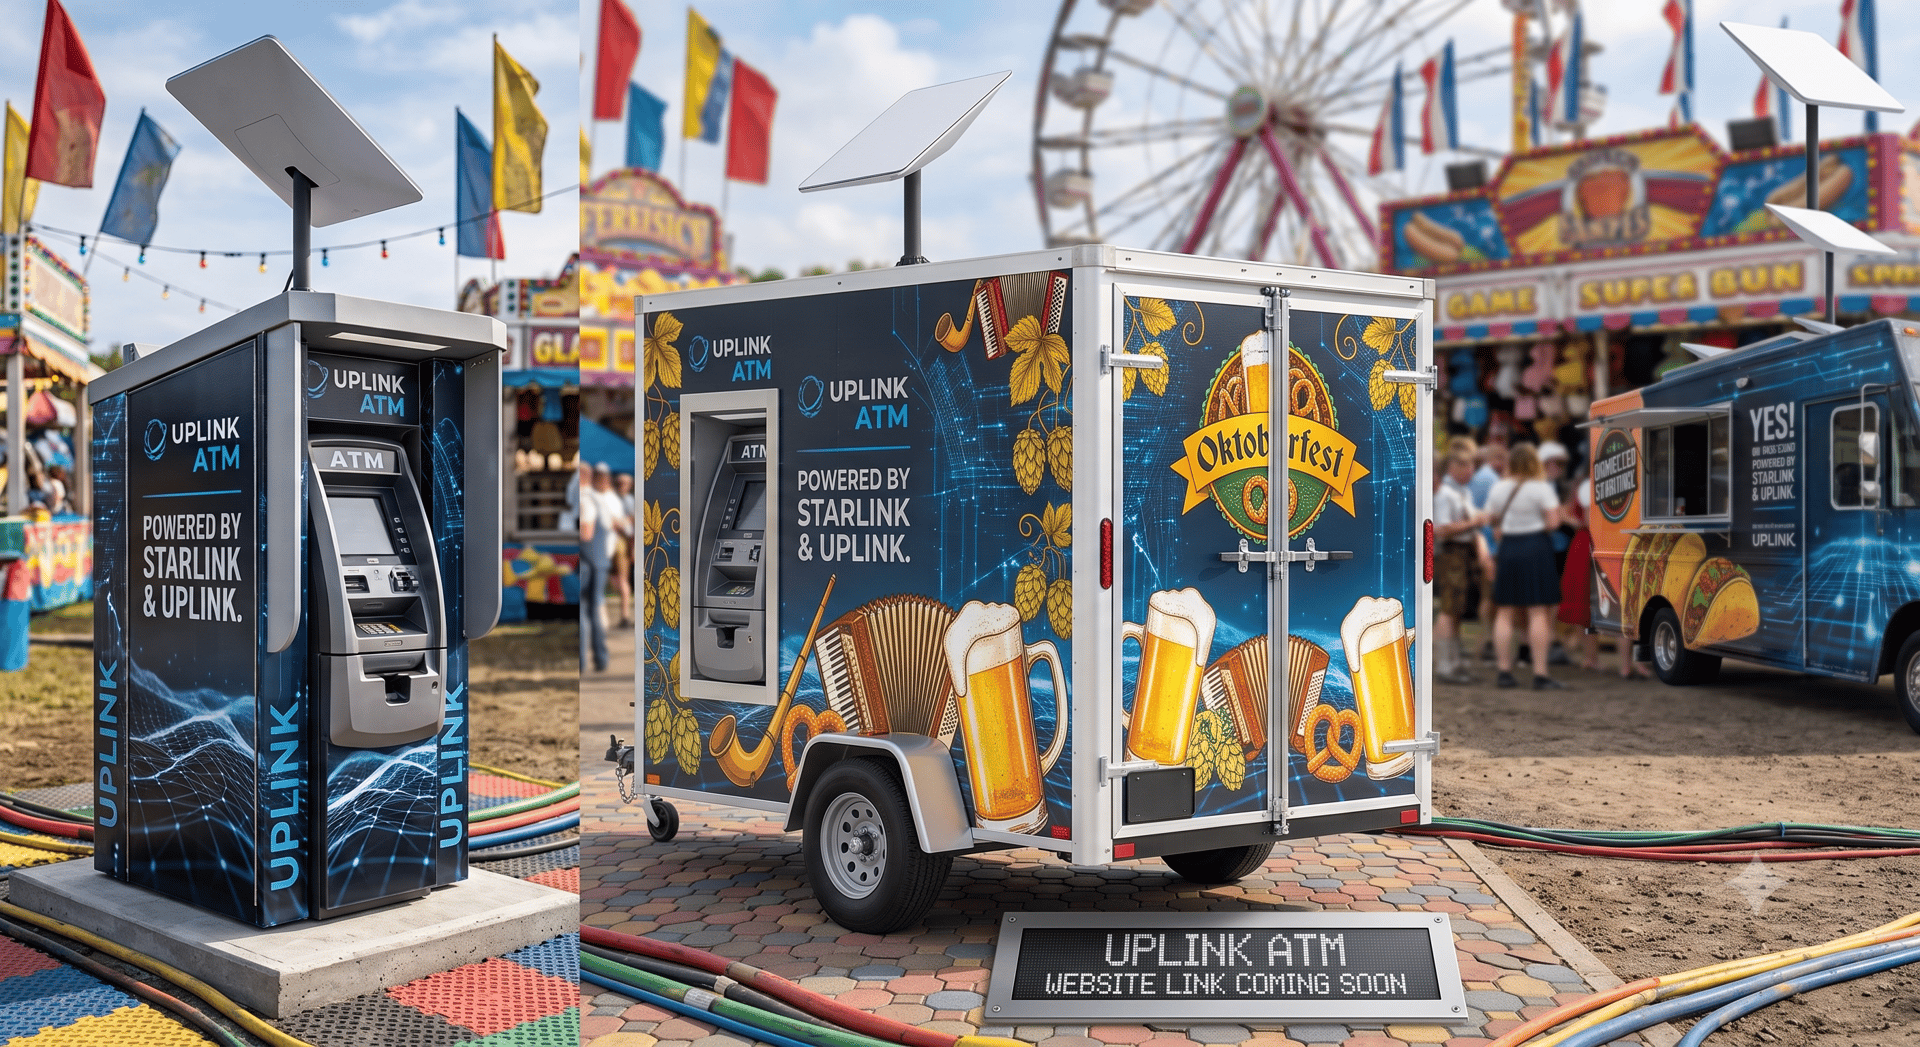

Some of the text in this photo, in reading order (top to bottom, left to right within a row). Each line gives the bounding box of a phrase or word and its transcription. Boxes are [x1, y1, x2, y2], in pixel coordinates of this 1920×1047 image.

[713, 335, 772, 358] UPLINK
[334, 368, 404, 394] UPLINK
[731, 359, 772, 383] ATM
[829, 376, 909, 402] UPLINK
[360, 395, 404, 417] ATM
[854, 404, 909, 430] ATM
[172, 416, 240, 445] UPLINK
[1750, 402, 1795, 442] YES!
[193, 445, 240, 472] ATM
[330, 449, 384, 469] ATM
[1197, 423, 1344, 478] Oktobrfest
[1752, 456, 1796, 470] POWERED BY
[797, 467, 911, 491] POWERED BY
[1752, 469, 1795, 485] STARLINK
[1752, 485, 1796, 501] & UPLINK.
[797, 498, 911, 527] STARLINK
[143, 512, 242, 541] POWERED BY
[797, 532, 911, 563] & UPLINK.
[143, 546, 242, 580] STARLINK
[143, 584, 243, 622] & UPLINK.
[100, 660, 118, 828] UPLINK
[440, 682, 464, 848] UPLINK
[270, 702, 299, 891] UPLINK
[1105, 933, 1346, 967] UPLINK ATM
[1045, 973, 1407, 995] WEBSITE LINK COMING SOON
